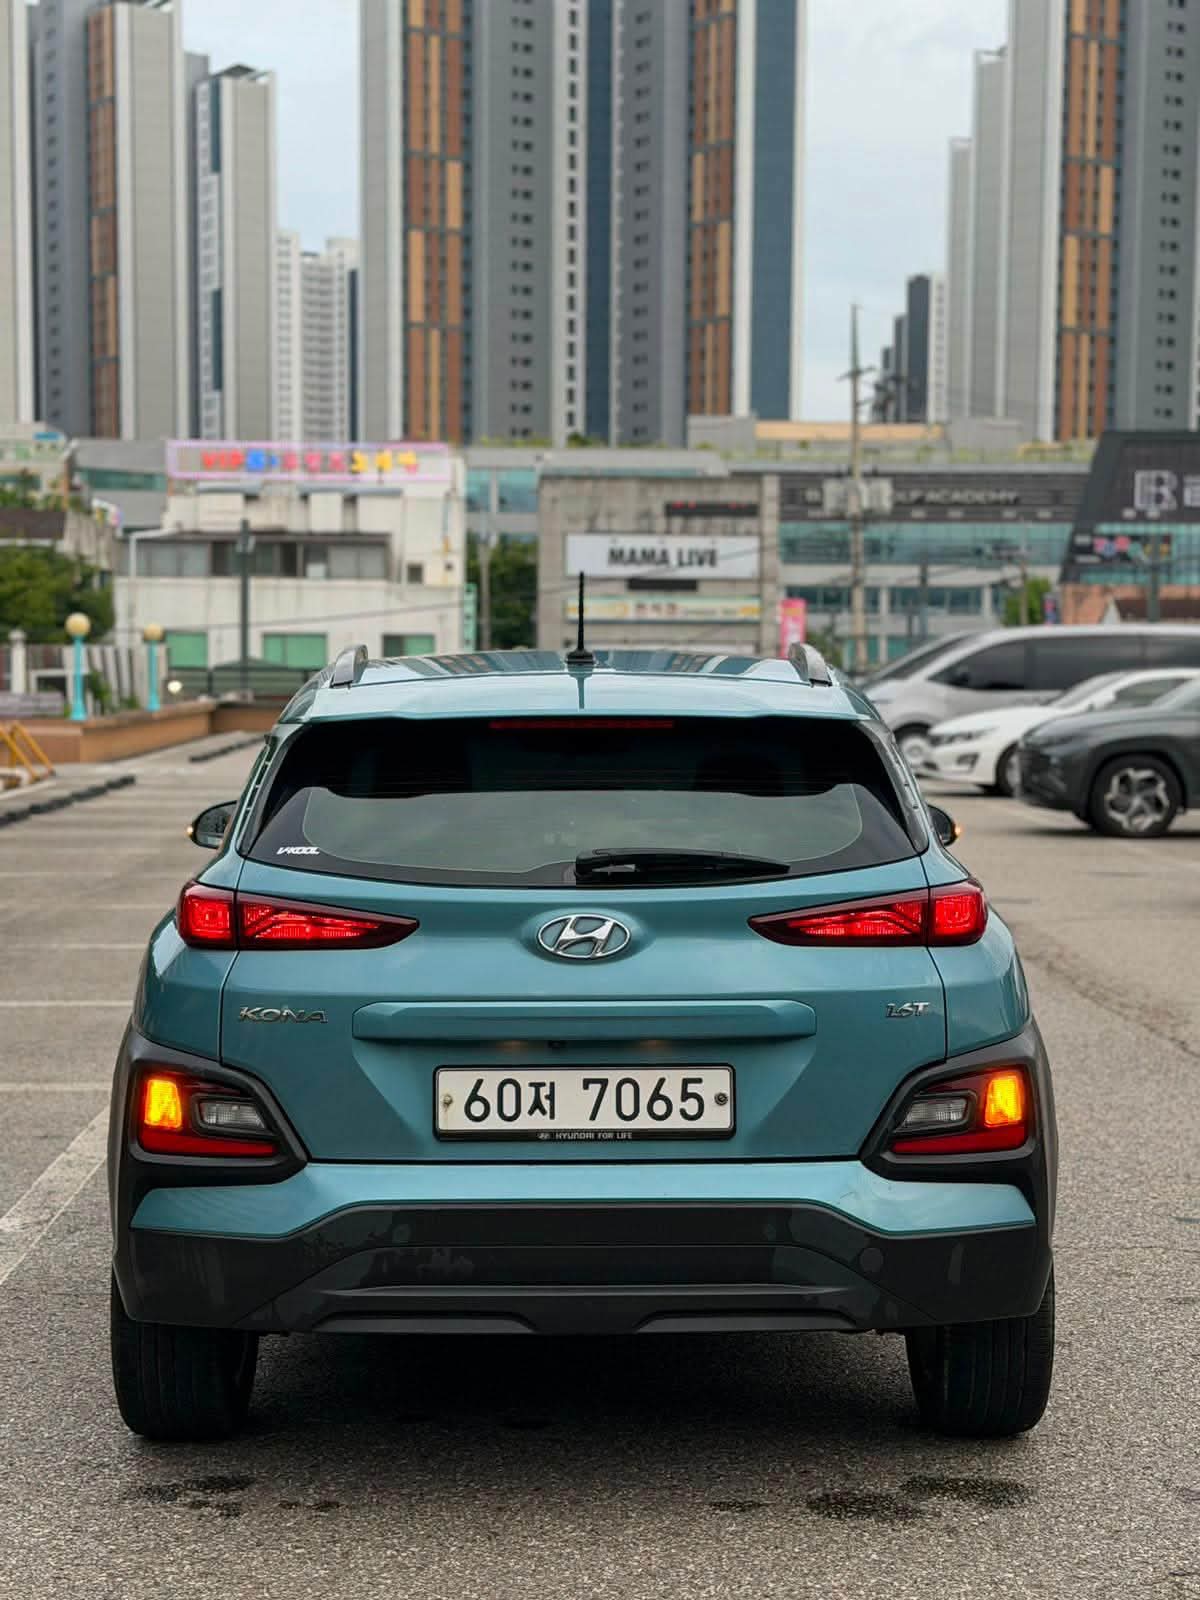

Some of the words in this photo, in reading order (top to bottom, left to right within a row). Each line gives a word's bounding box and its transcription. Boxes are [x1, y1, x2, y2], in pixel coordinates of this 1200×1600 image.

[608, 547, 671, 566] MAMA
[676, 547, 718, 568] LIVE
[238, 1006, 328, 1023] KONA
[463, 1078, 556, 1123] 60저
[581, 1076, 705, 1122] 7065
[555, 1131, 595, 1140] HYUNDAI
[597, 1131, 614, 1140] FOR
[616, 1131, 633, 1140] LIFE
